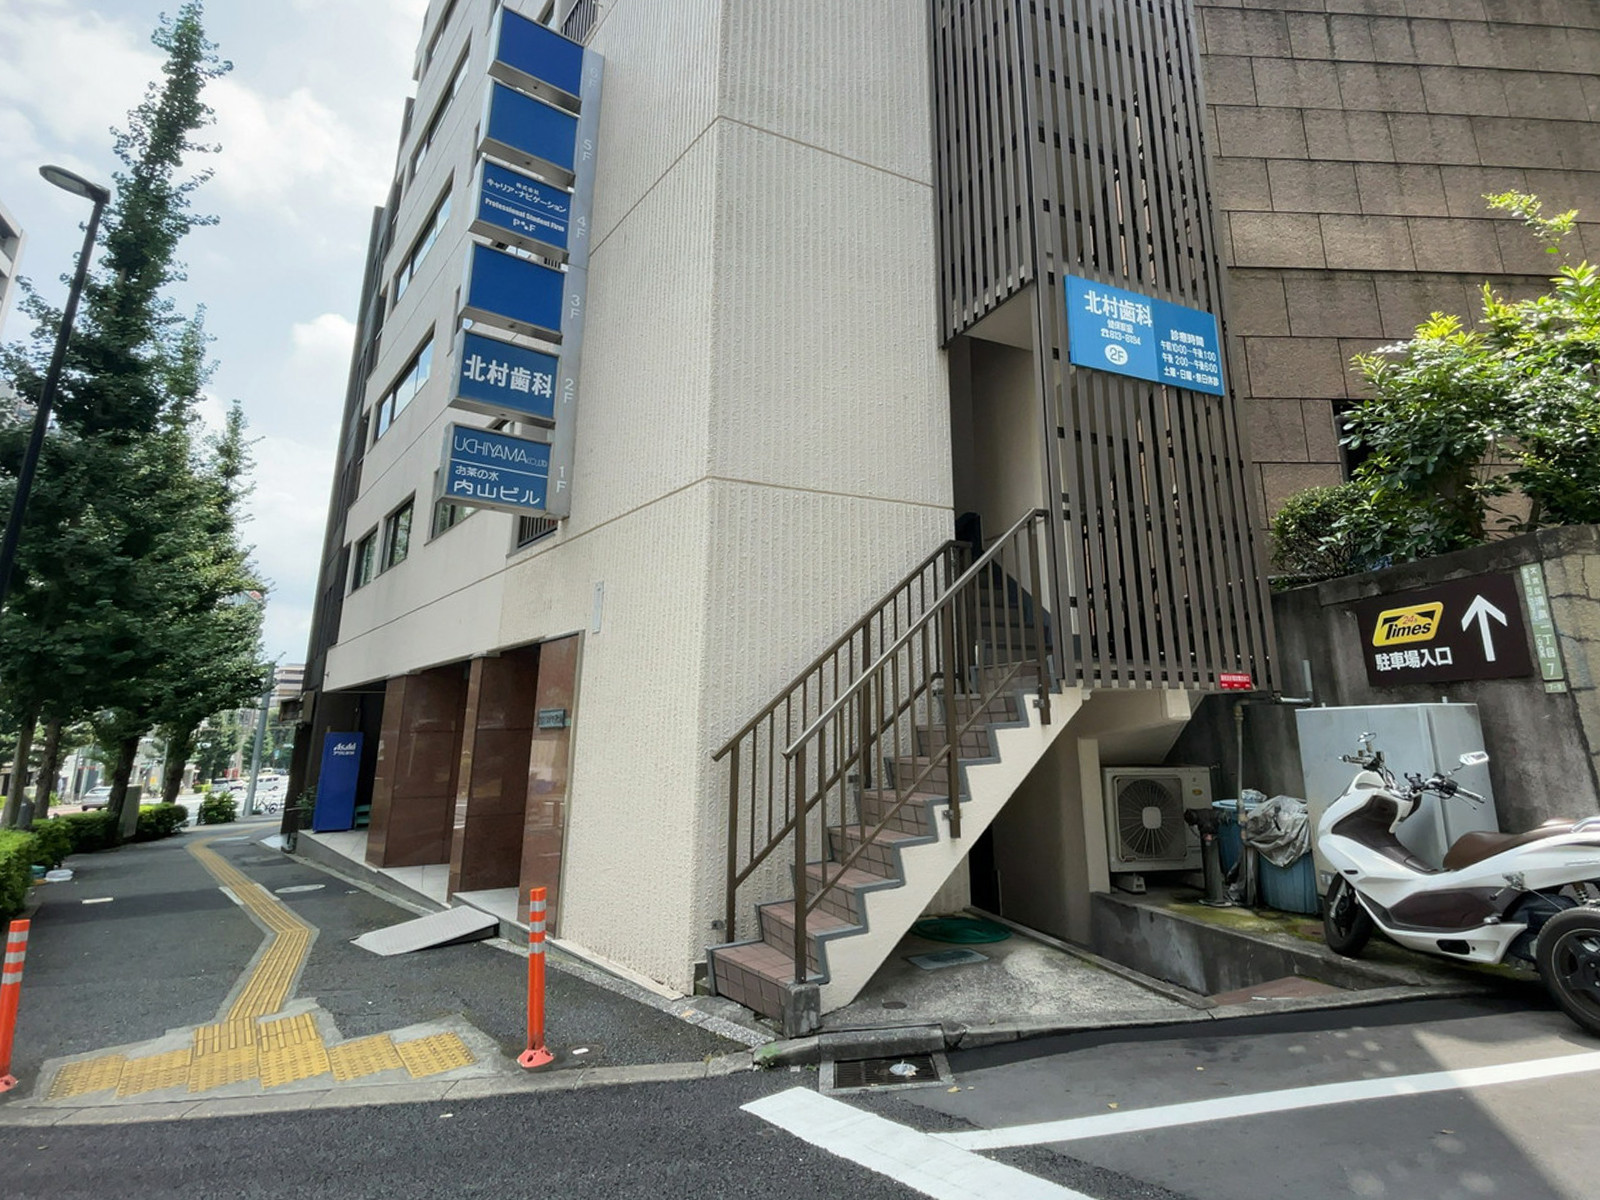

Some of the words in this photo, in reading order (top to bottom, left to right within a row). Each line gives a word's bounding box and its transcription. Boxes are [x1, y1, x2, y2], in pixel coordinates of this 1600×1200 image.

[484, 197, 526, 218] Professional
[525, 212, 551, 228] Student
[576, 216, 587, 239] 4F
[570, 294, 581, 319] 3F
[1083, 289, 1153, 328] 北村歯科
[1169, 329, 1205, 348] 診療時間
[1109, 347, 1125, 362] 2F
[463, 353, 553, 399] 北村歯科
[564, 378, 574, 404] 2F
[454, 435, 527, 463] UCHIYAMA
[454, 465, 499, 481] お茶の水
[556, 465, 567, 493] 1F
[453, 479, 540, 505] 内山ビル
[1381, 617, 1432, 641] Times
[1374, 646, 1453, 672] 駐車場入口
[1546, 663, 1555, 676] 7
